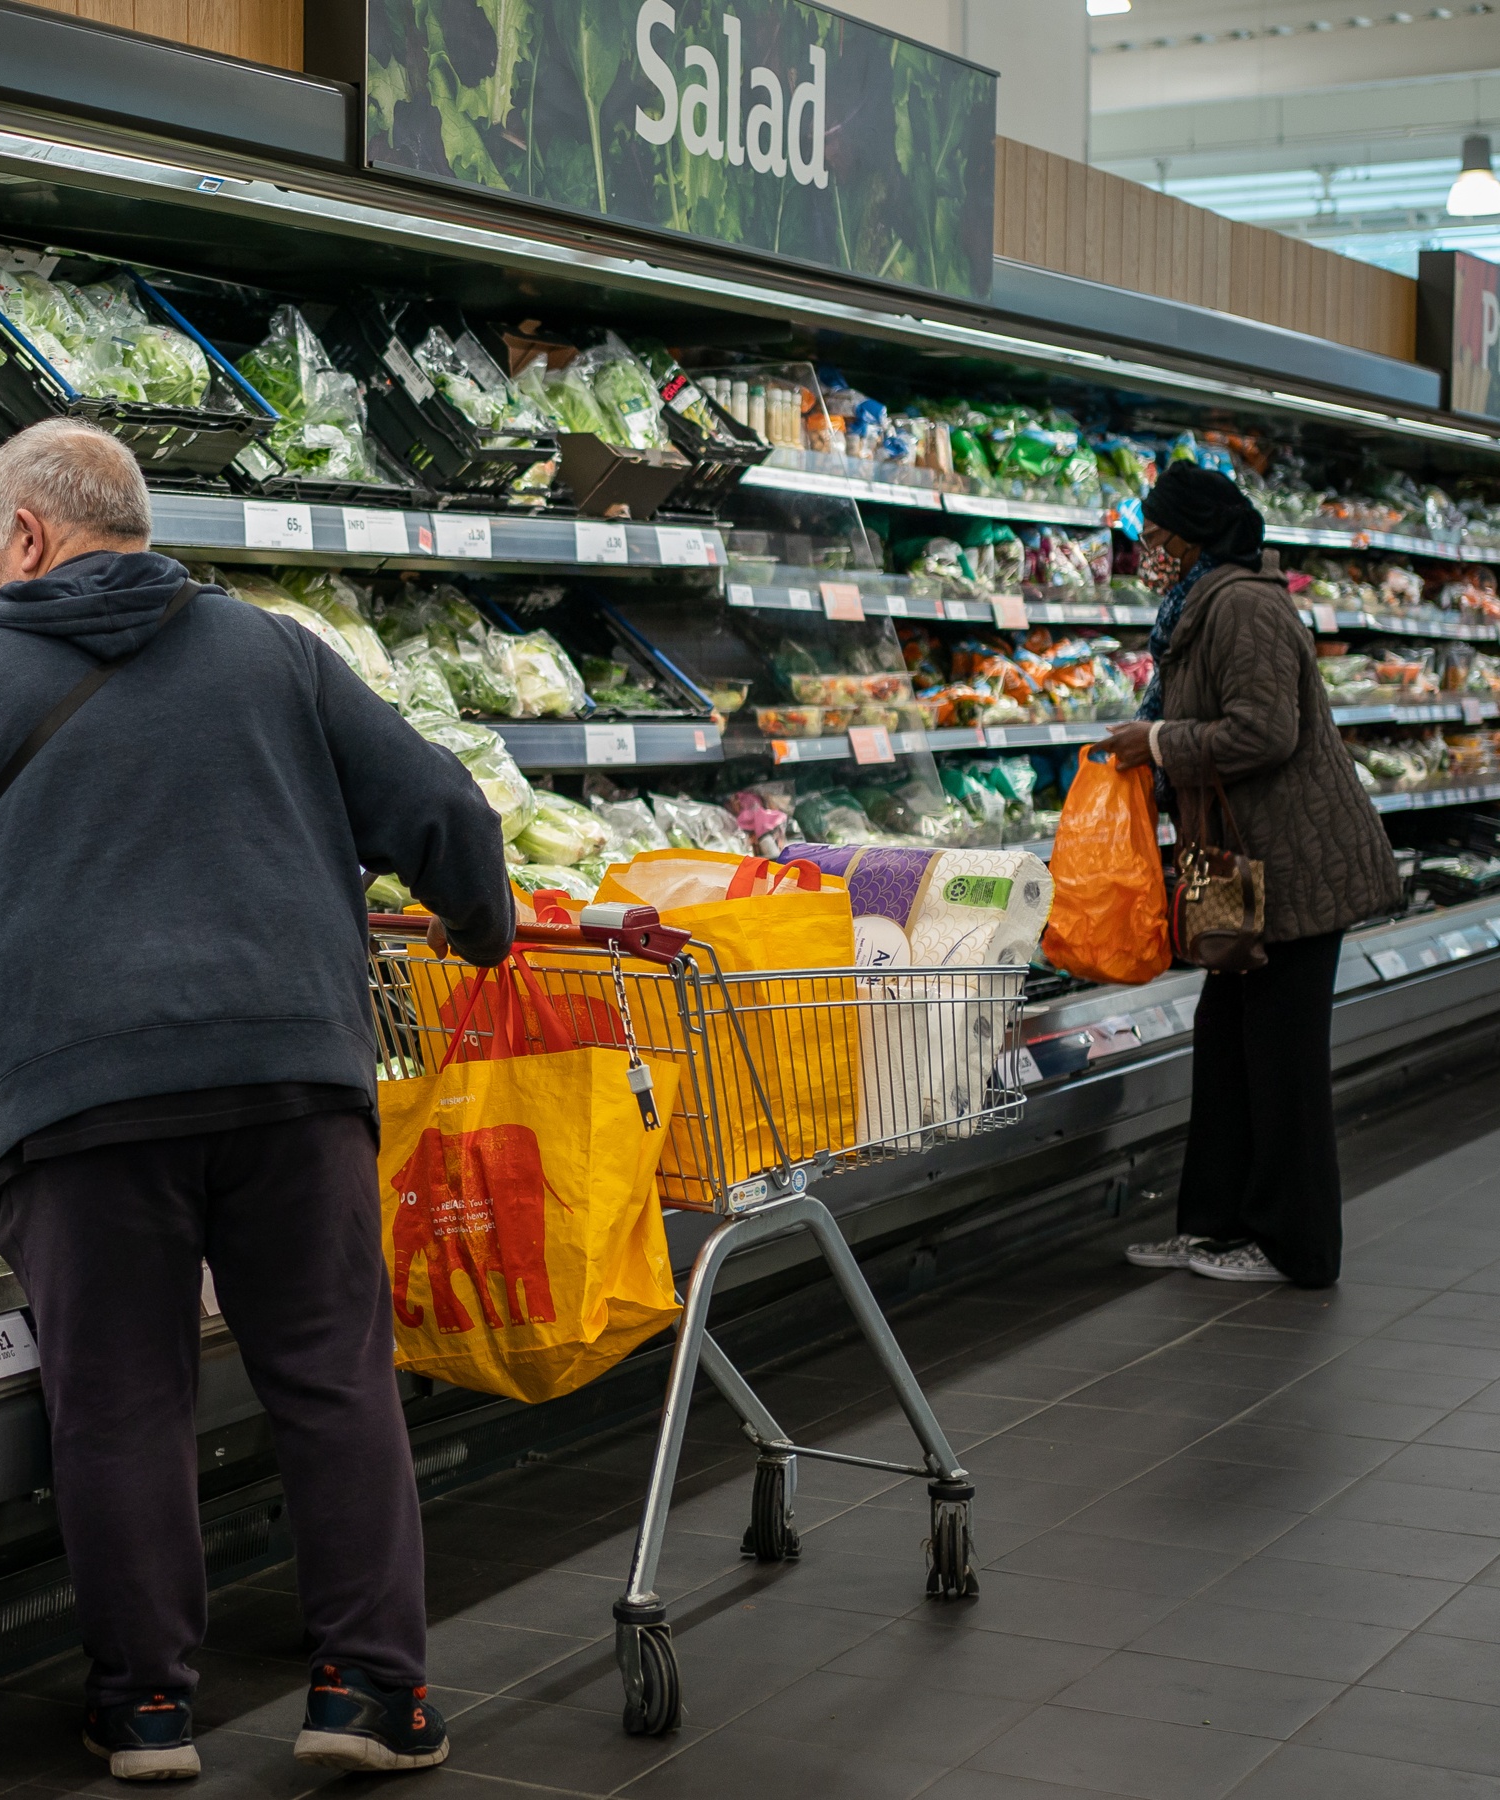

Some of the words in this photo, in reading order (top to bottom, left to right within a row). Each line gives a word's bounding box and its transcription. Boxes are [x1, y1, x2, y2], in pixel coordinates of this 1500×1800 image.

[635, 0, 829, 189] Salad
[1482, 289, 1500, 372] P
[287, 517, 302, 533] 65p
[347, 520, 365, 530] INFO
[469, 1200, 483, 1208] You
[467, 1212, 488, 1221] heavy
[474, 1222, 496, 1233] forget
[3, 1351, 11, 1360] 100
